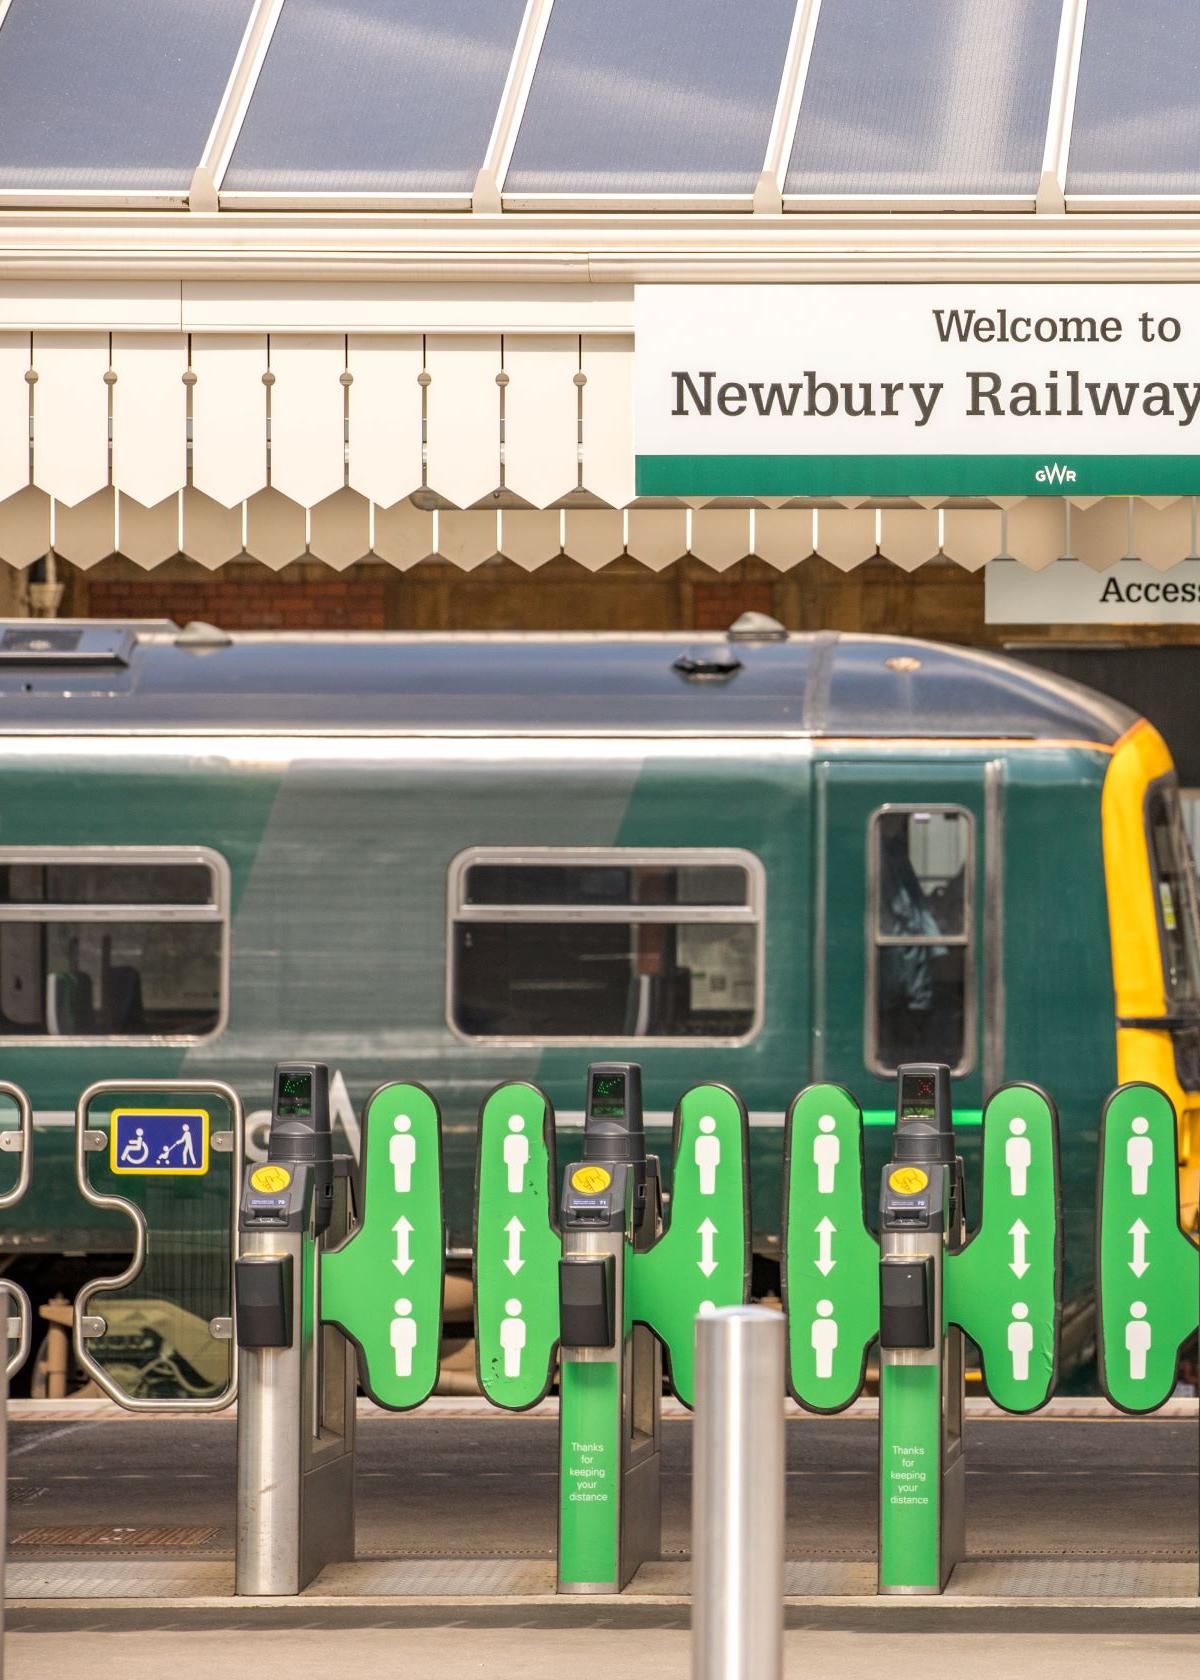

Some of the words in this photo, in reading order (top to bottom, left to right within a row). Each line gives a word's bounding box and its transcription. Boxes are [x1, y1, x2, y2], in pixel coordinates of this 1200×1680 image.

[932, 309, 1123, 343] Welcome
[1138, 311, 1181, 343] to
[671, 370, 944, 427] Newbury
[1035, 462, 1077, 485] GWR
[571, 1442, 604, 1452] Thanks
[892, 1445, 925, 1455] Thanks
[581, 1455, 593, 1464] for
[902, 1458, 915, 1468] for
[569, 1467, 605, 1478] keeping
[890, 1471, 926, 1482] keeping
[577, 1481, 597, 1490] your
[898, 1484, 918, 1493] your
[569, 1493, 608, 1501] distance
[890, 1496, 929, 1504] distance
